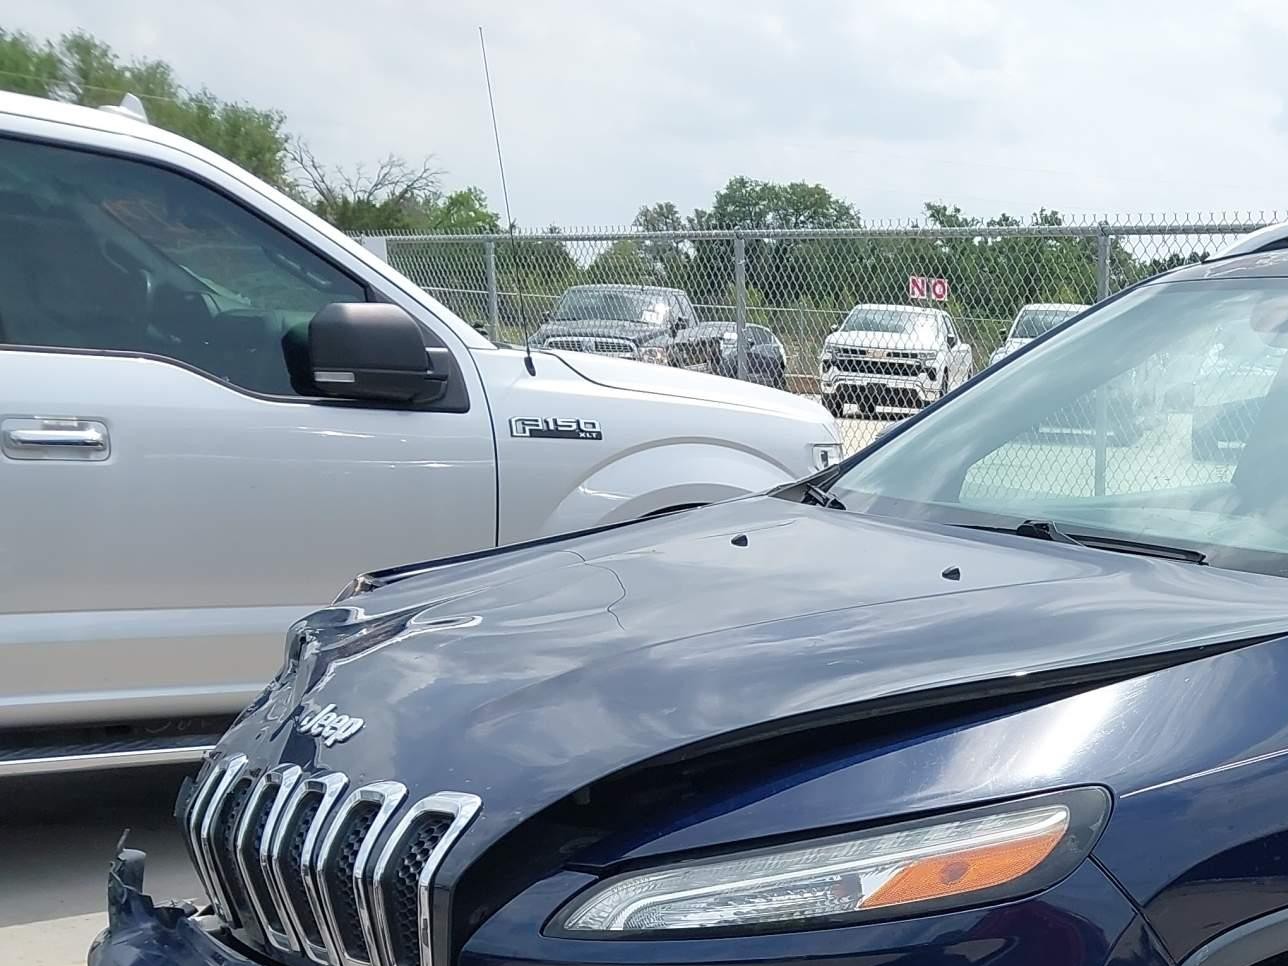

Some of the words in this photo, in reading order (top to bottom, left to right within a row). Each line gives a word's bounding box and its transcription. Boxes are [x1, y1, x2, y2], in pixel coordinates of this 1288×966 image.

[910, 277, 948, 299] NO
[509, 416, 602, 437] F150
[297, 704, 364, 747] Jeep
